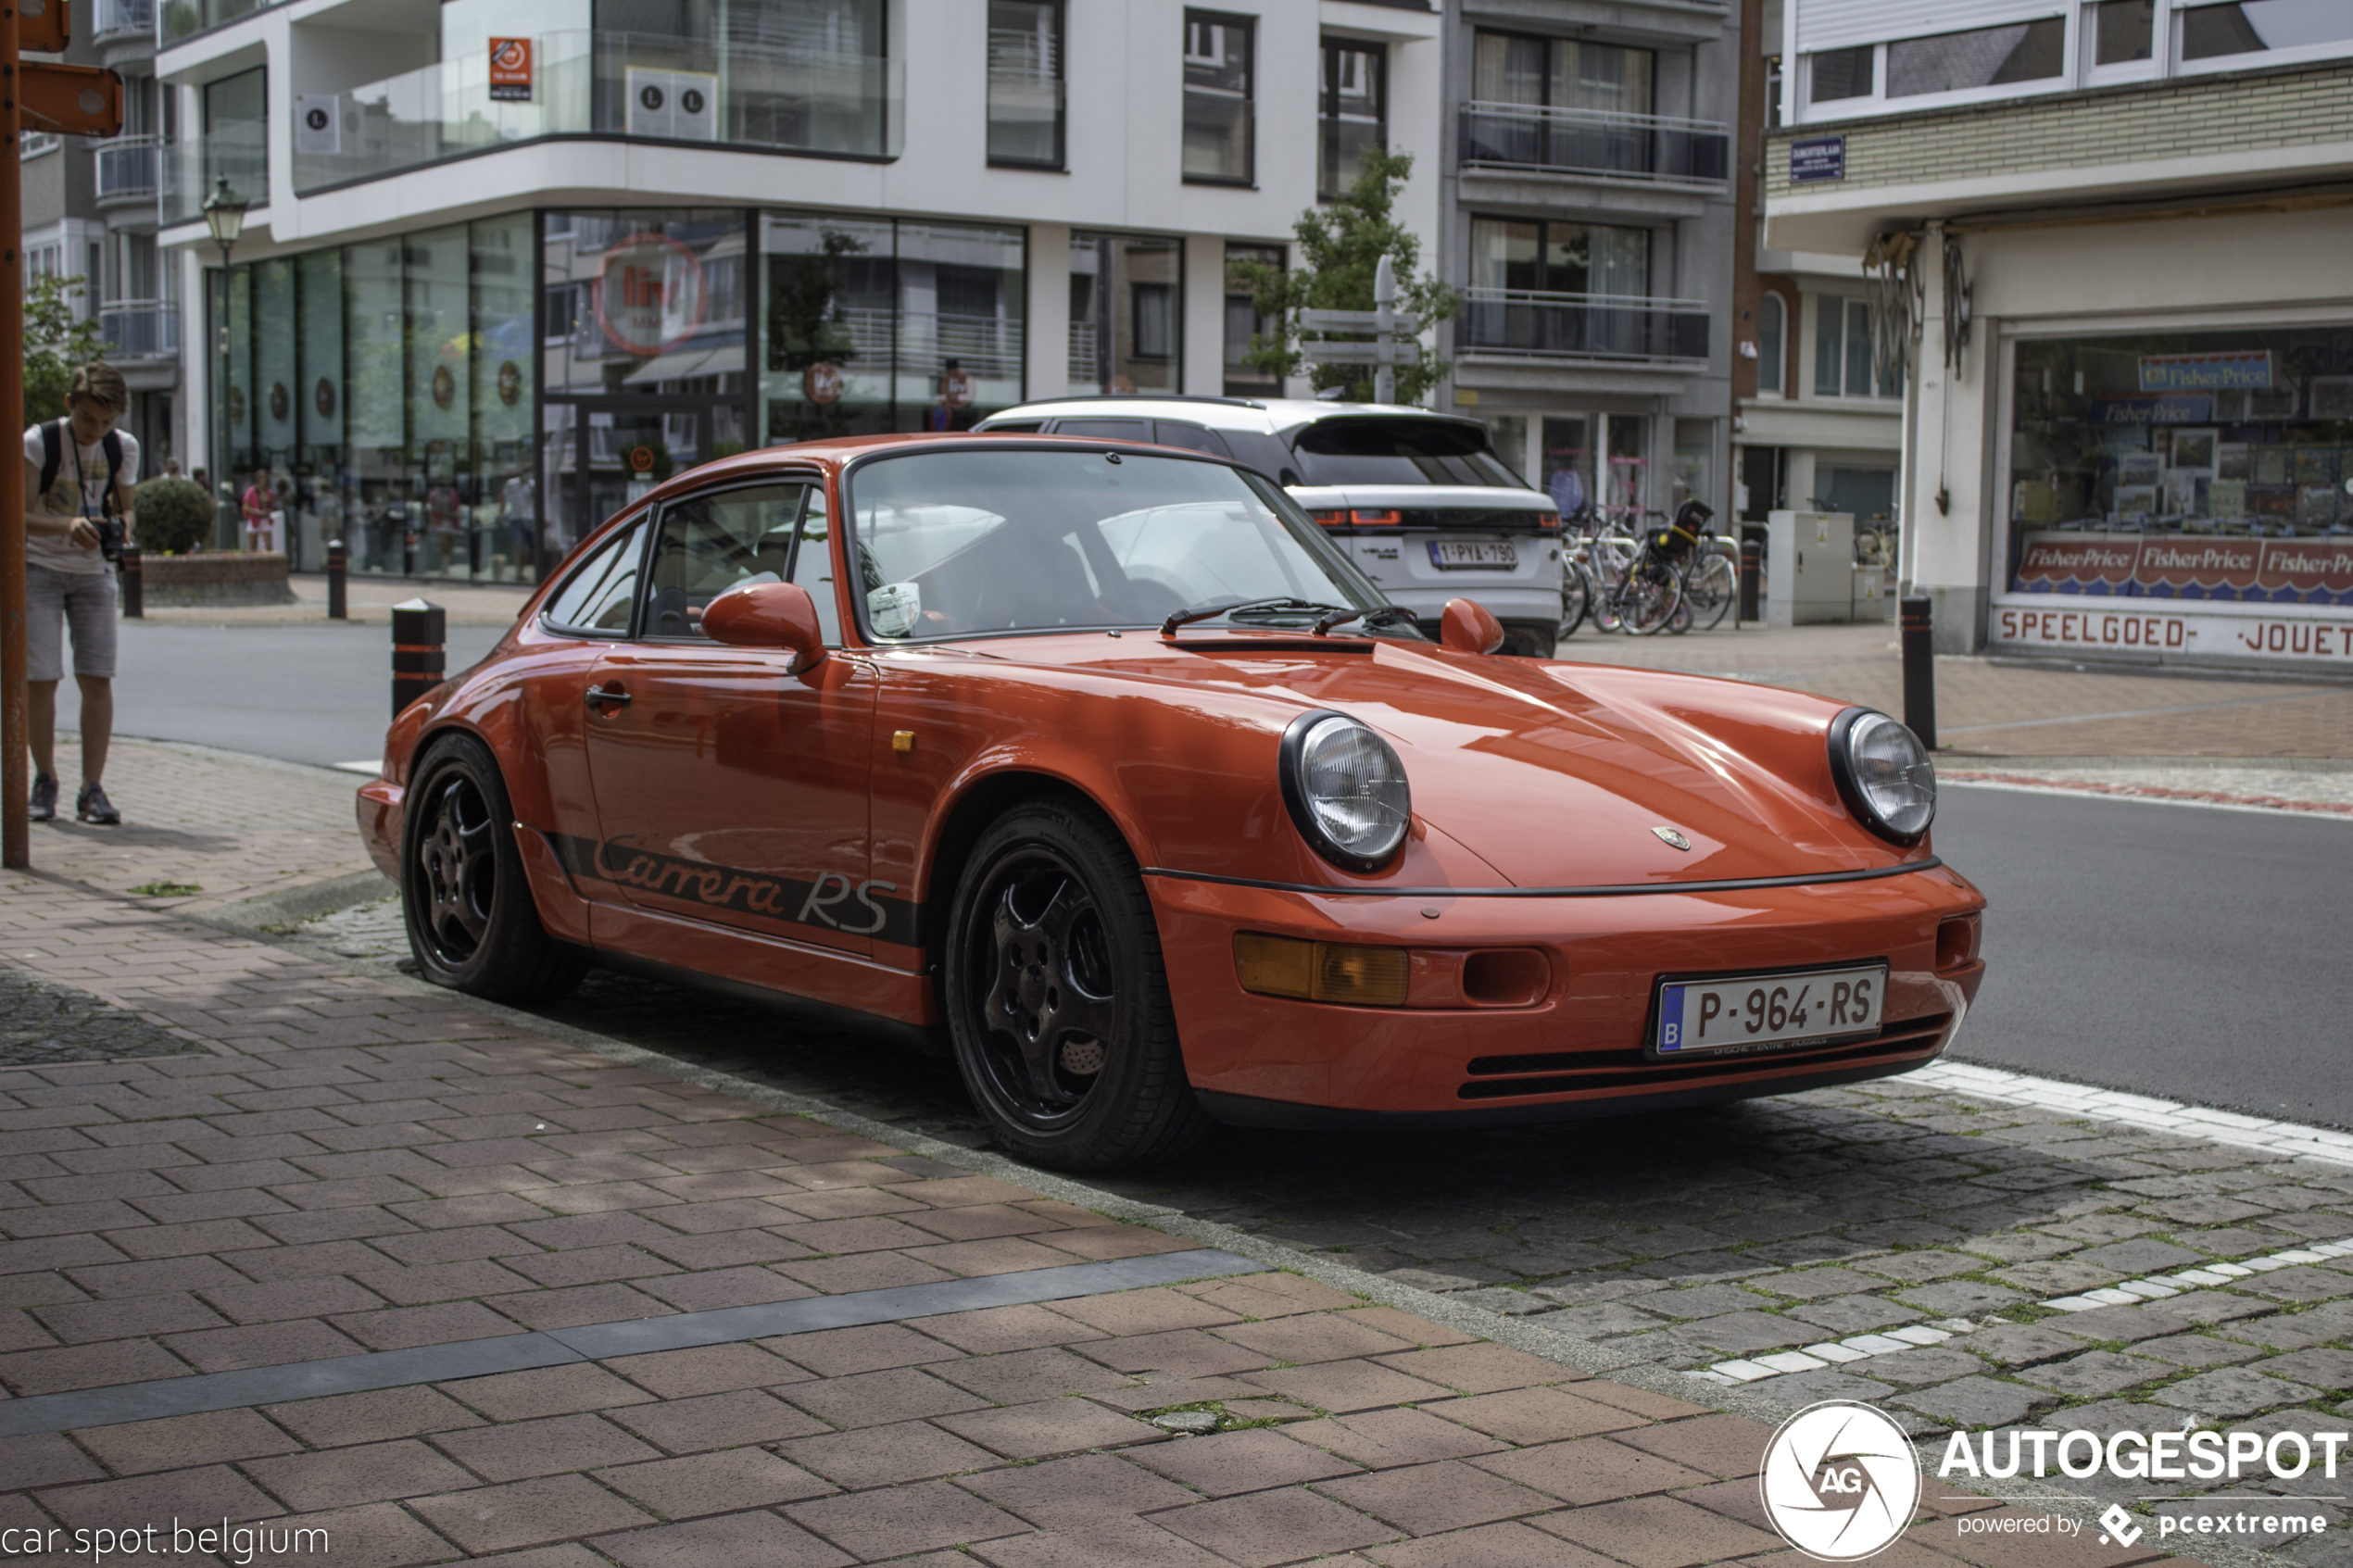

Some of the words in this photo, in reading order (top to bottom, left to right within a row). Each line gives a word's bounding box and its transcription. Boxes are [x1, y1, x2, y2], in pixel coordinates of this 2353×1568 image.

[1441, 544, 1516, 562] 1-PYA-790
[2028, 547, 2130, 568] Fisher-Price
[2143, 547, 2252, 571] Fisher-Price
[594, 834, 784, 914] Carrera
[797, 871, 898, 934] RS
[1698, 978, 1872, 1037] P-964-RS
[1665, 1022, 1678, 1045] B
